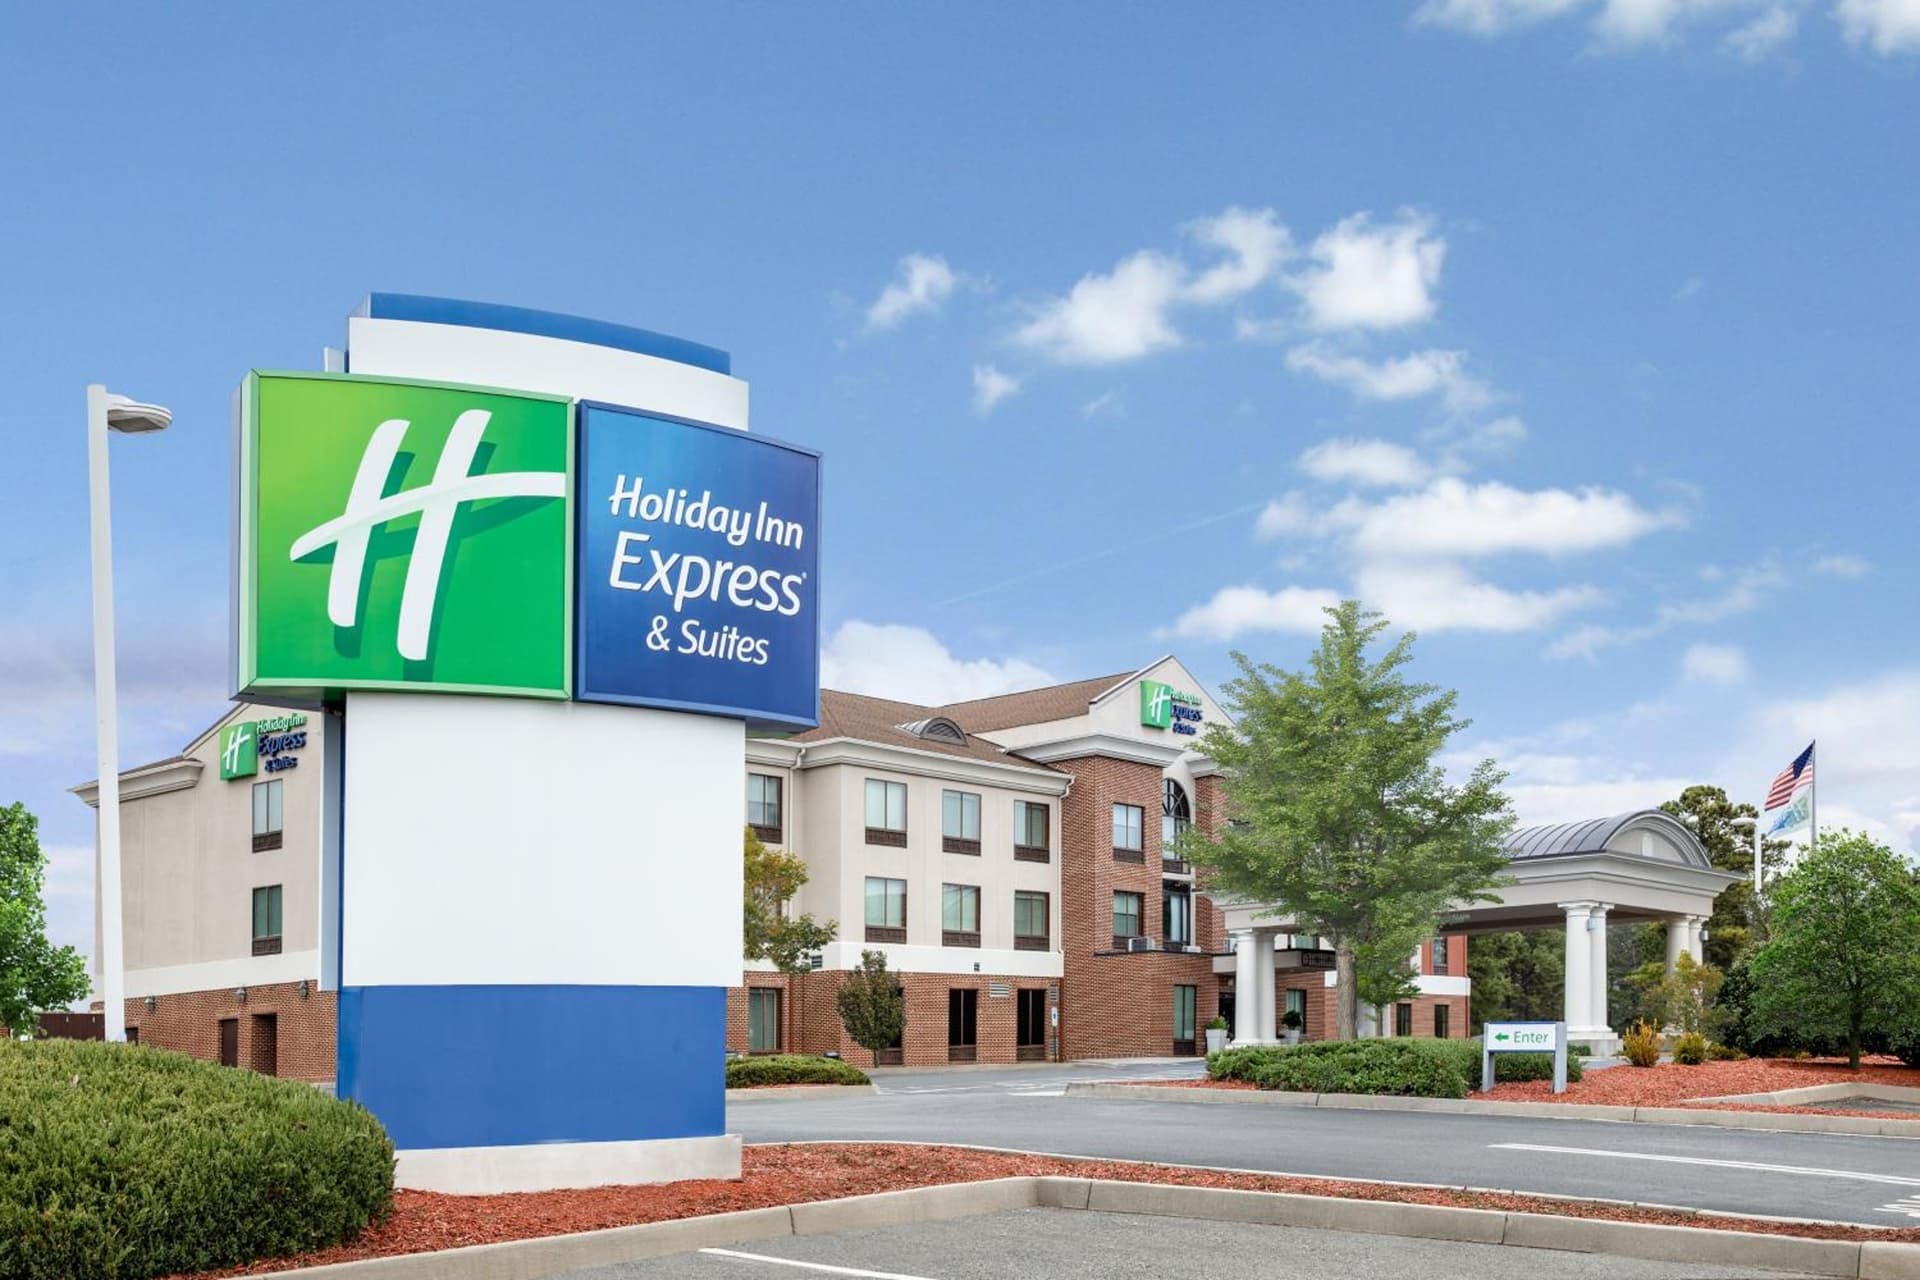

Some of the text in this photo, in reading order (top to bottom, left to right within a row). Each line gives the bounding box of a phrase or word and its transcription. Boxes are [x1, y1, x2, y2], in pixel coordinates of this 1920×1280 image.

[608, 474, 803, 549] Holiday Inn
[609, 531, 802, 616] Express
[646, 615, 769, 665] & Suites
[257, 716, 290, 734] Holiday
[257, 732, 307, 757] Express
[1514, 1031, 1549, 1043] Enter
